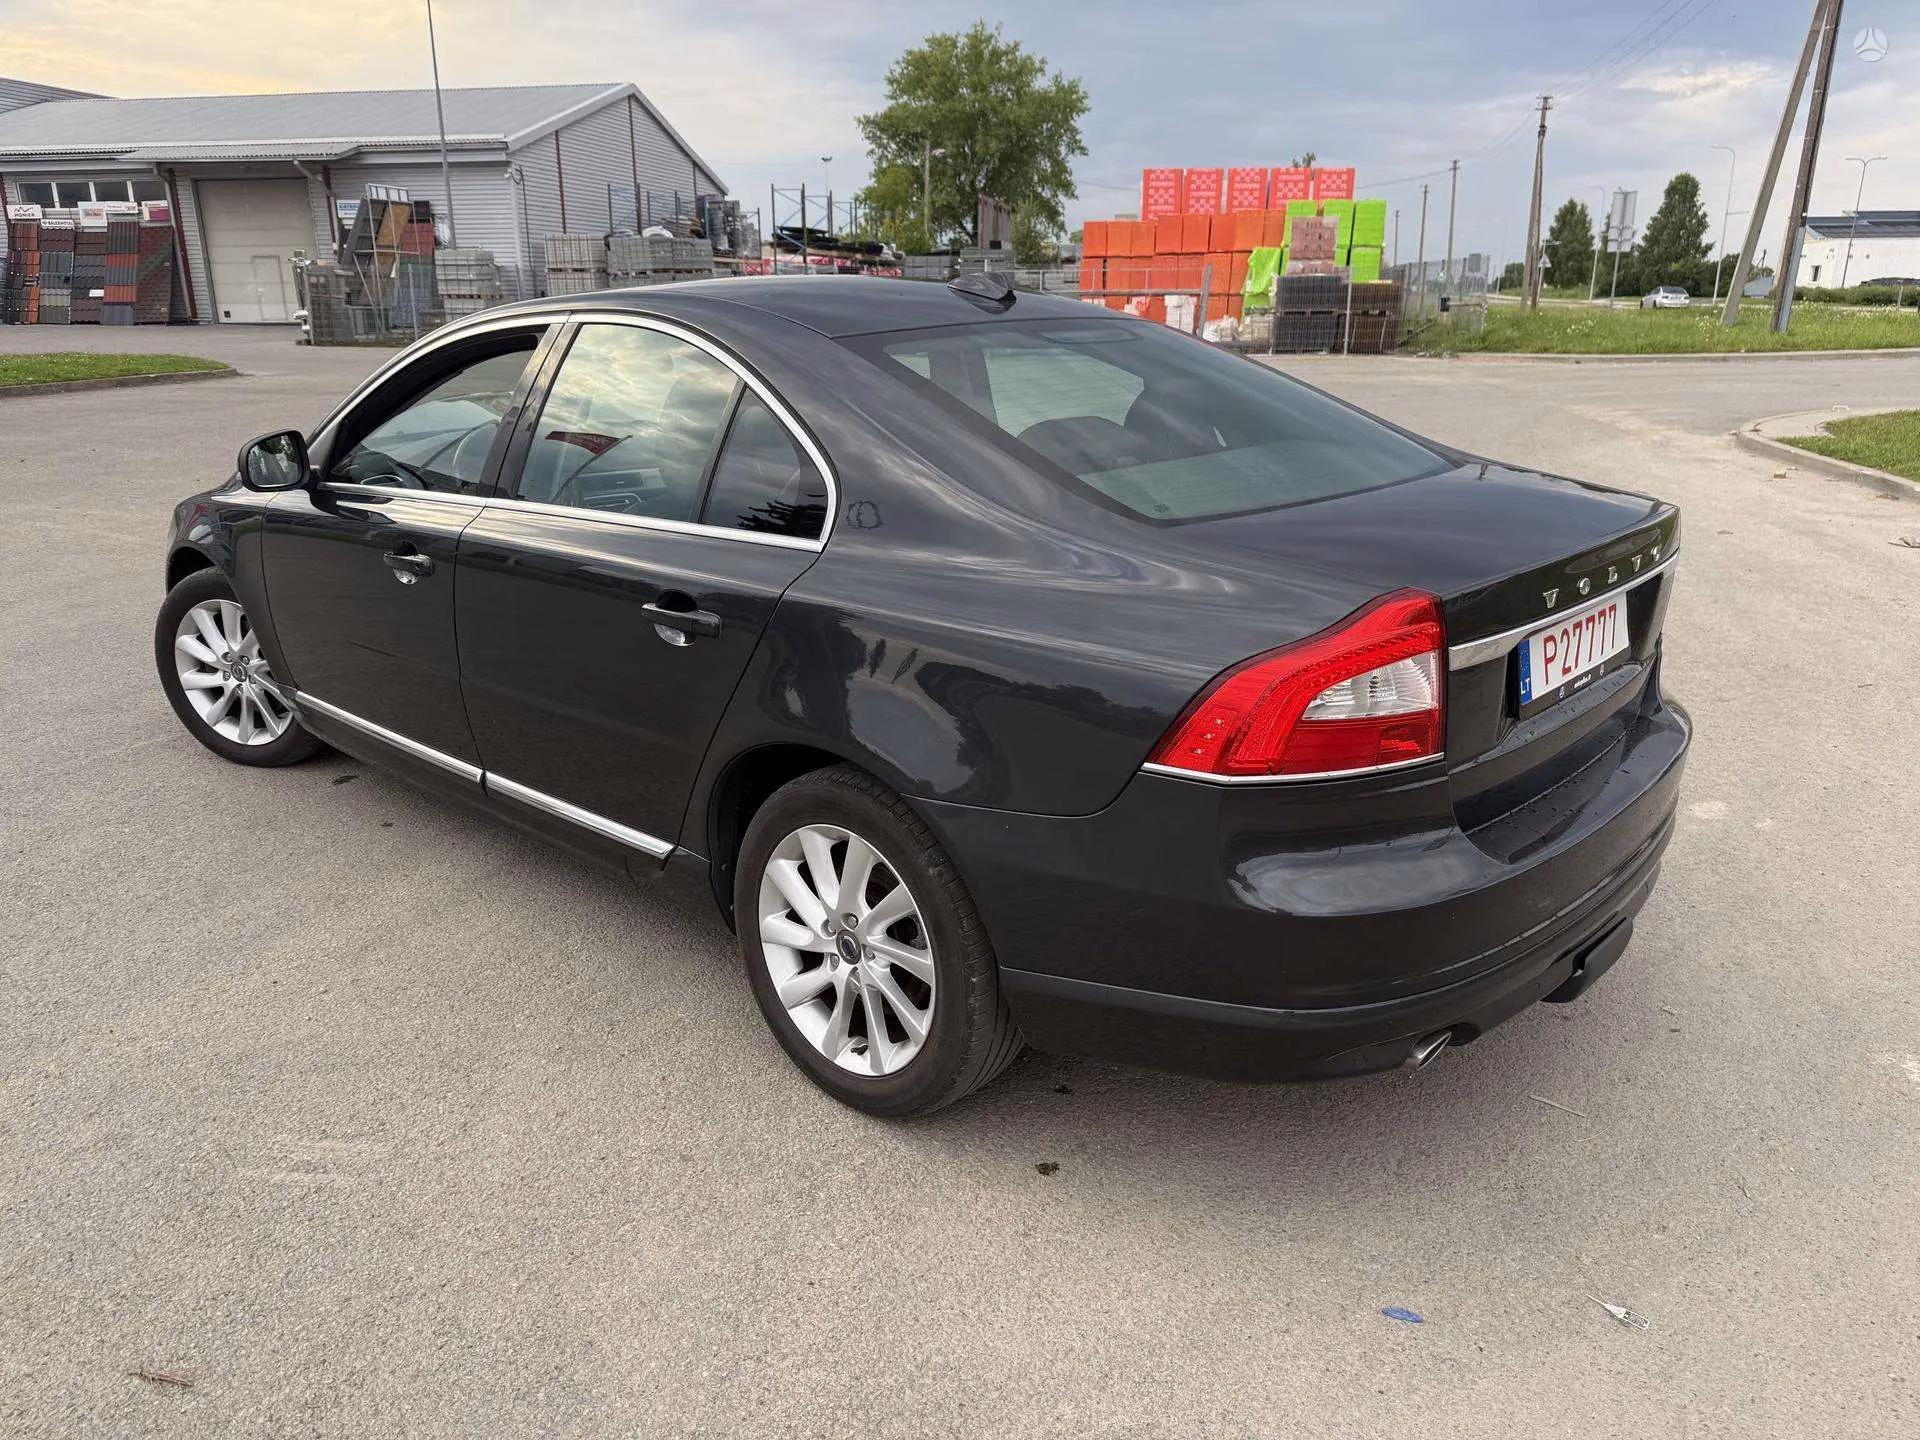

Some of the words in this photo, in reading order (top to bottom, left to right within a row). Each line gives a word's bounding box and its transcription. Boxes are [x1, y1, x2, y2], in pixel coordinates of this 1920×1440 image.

[1541, 546, 1661, 609] VOLVO
[1543, 603, 1617, 686] P27777
[1520, 677, 1531, 695] LT
